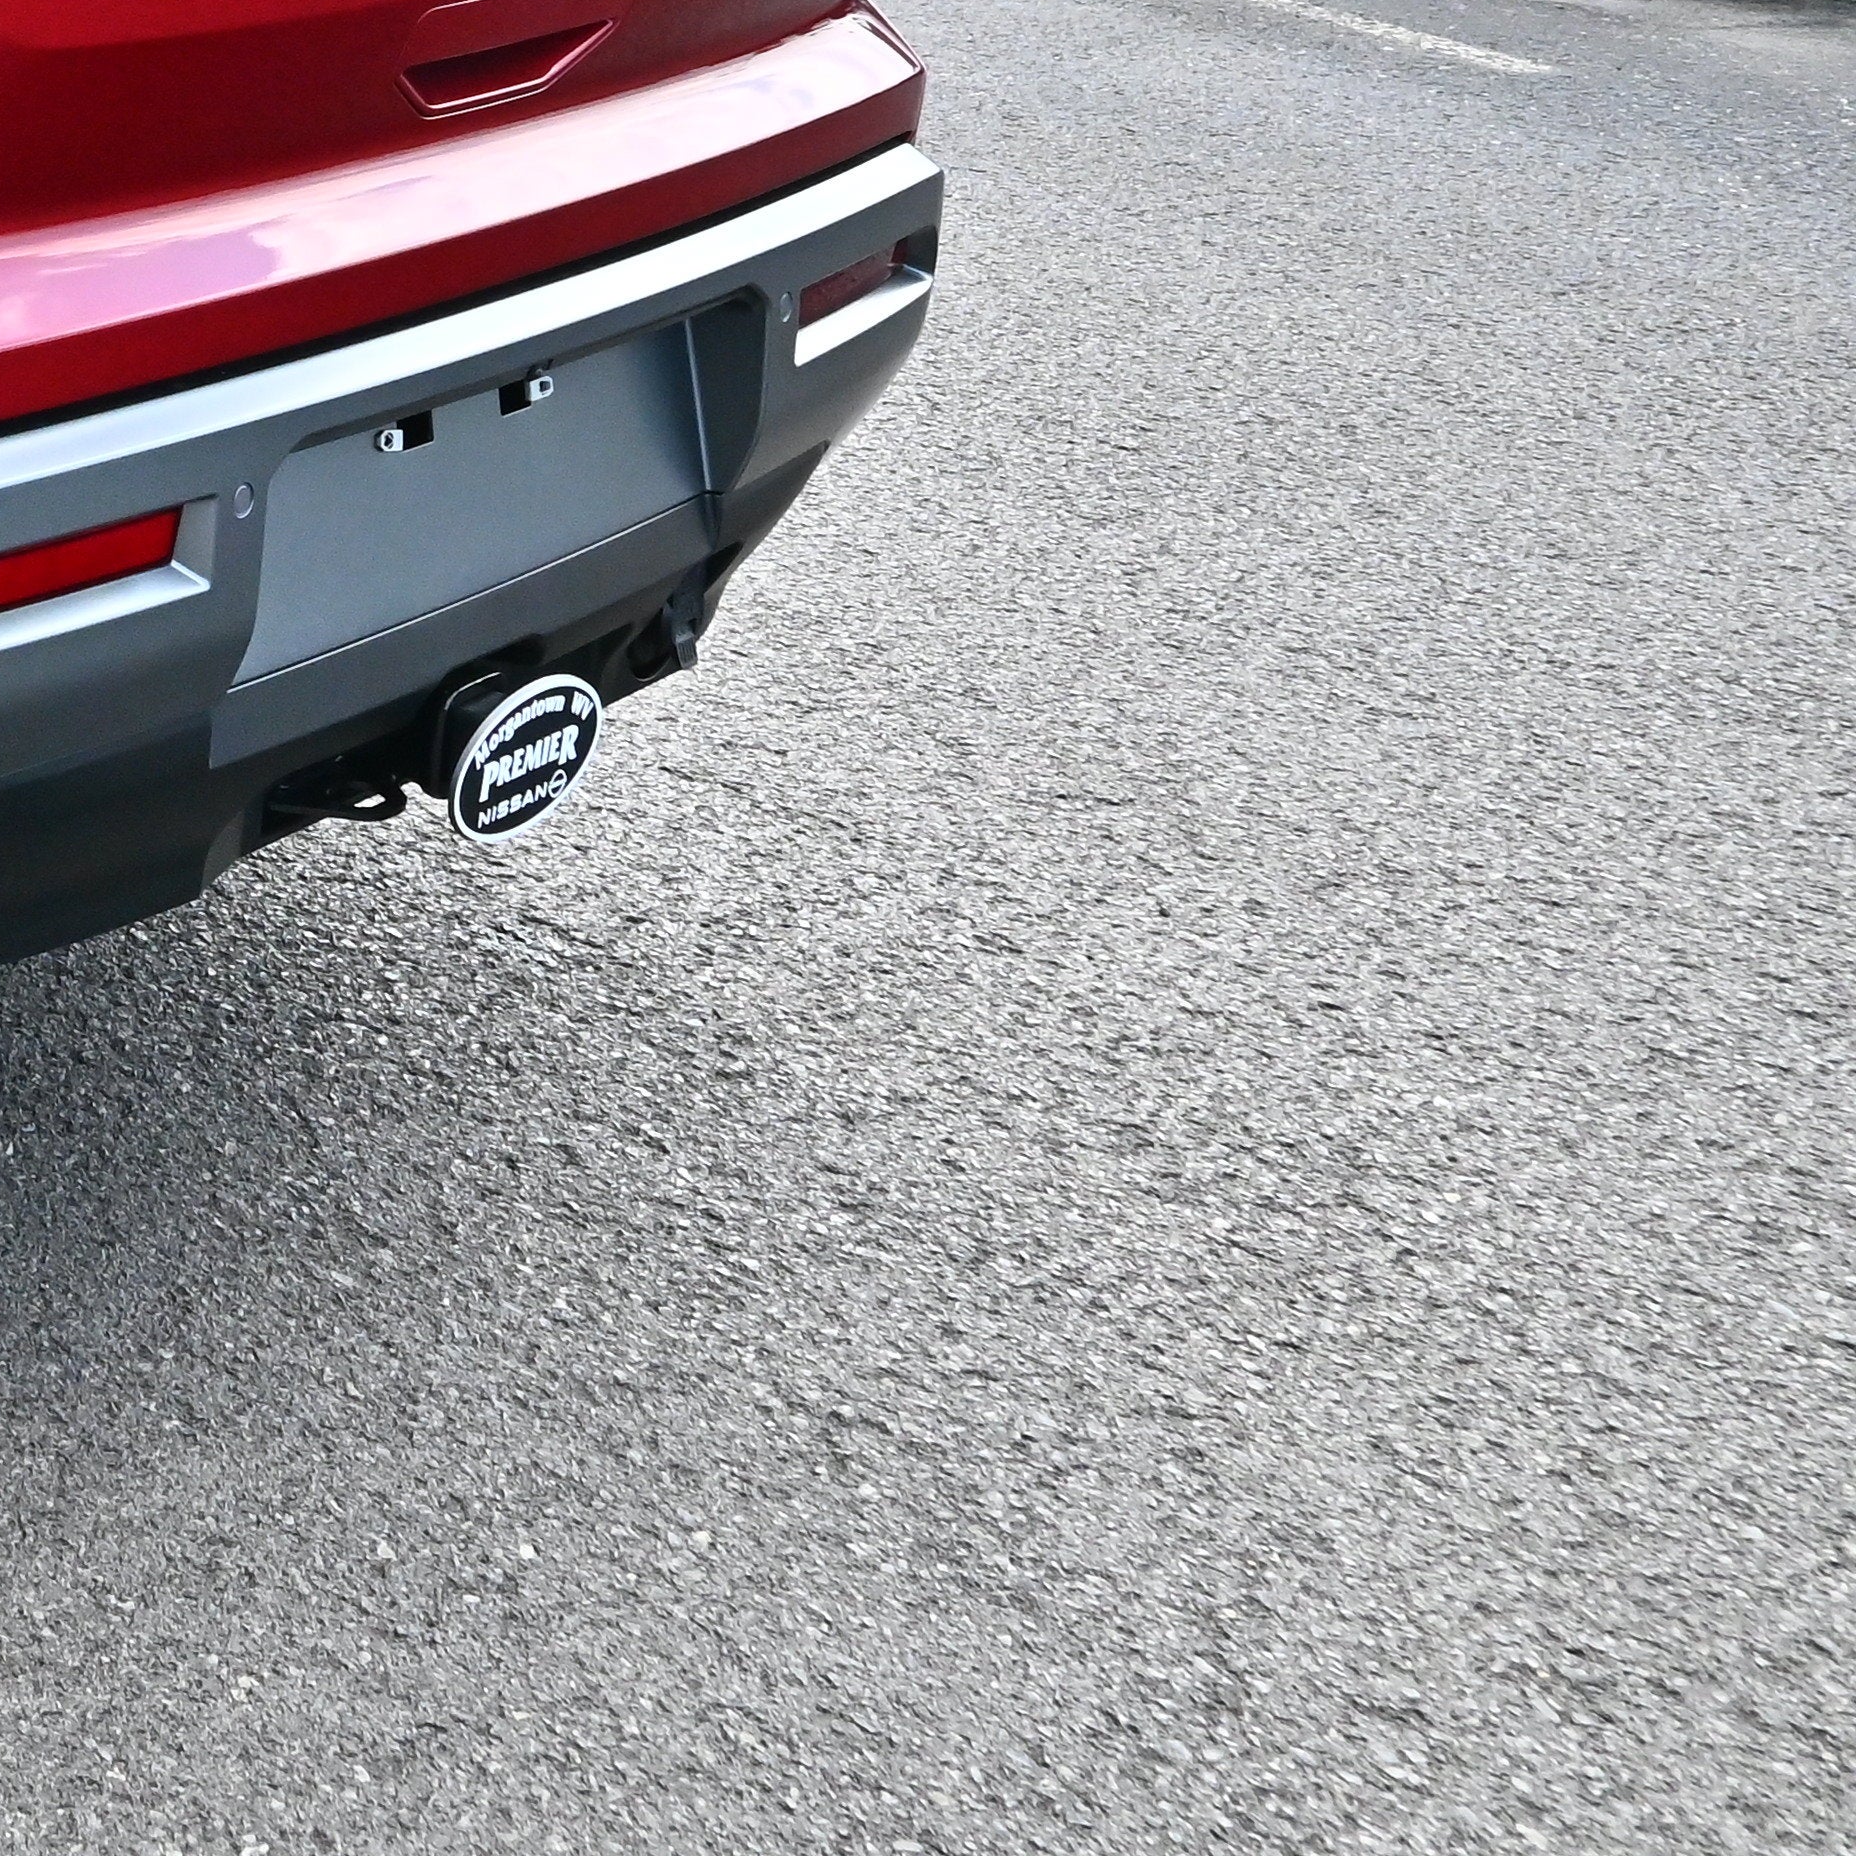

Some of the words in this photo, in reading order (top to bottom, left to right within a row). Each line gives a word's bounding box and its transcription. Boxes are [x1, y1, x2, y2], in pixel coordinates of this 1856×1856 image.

[473, 694, 566, 771] Morgantown
[570, 690, 595, 721] WV
[478, 724, 580, 803] PREMIER
[476, 781, 548, 829] NISSAN
